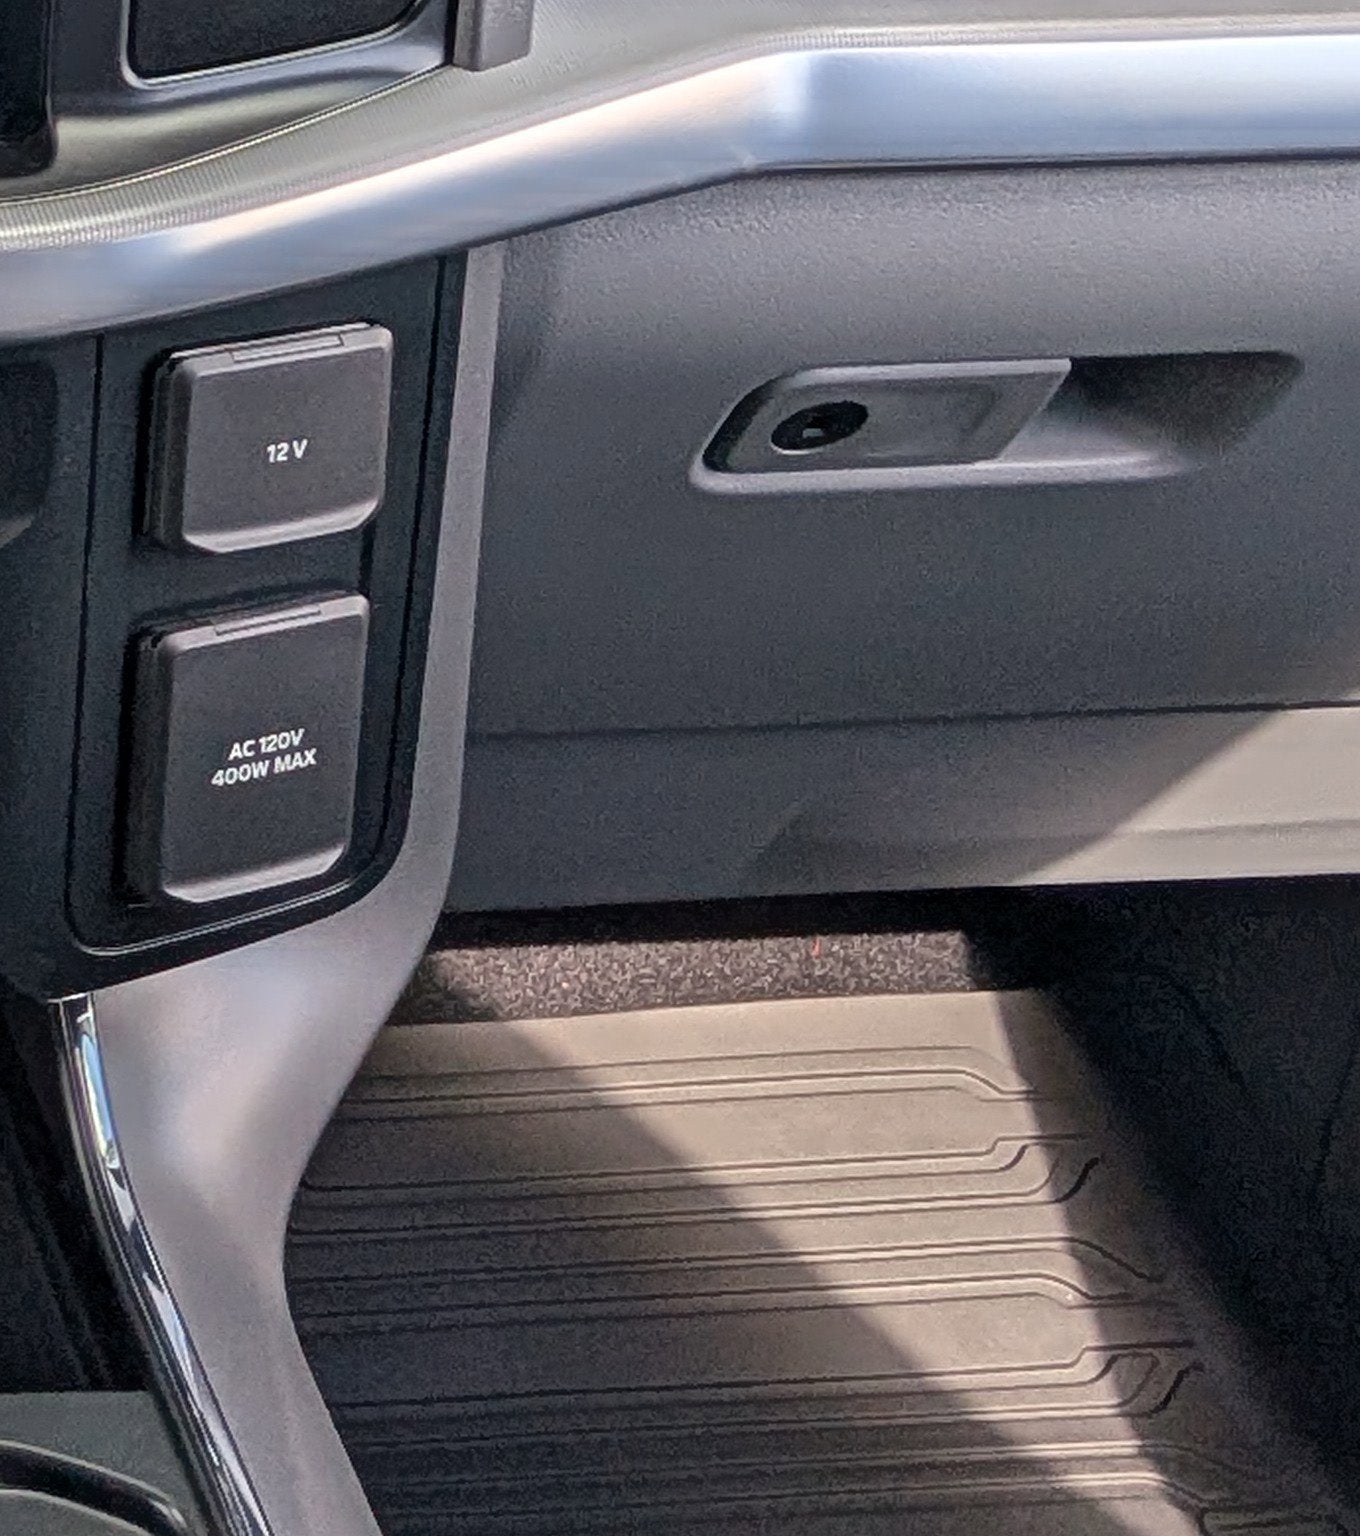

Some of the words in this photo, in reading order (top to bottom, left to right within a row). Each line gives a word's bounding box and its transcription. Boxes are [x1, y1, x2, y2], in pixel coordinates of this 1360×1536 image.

[227, 737, 257, 761] AC
[259, 728, 306, 751] 120V
[211, 757, 270, 788] 400W
[274, 748, 318, 774] MAX
